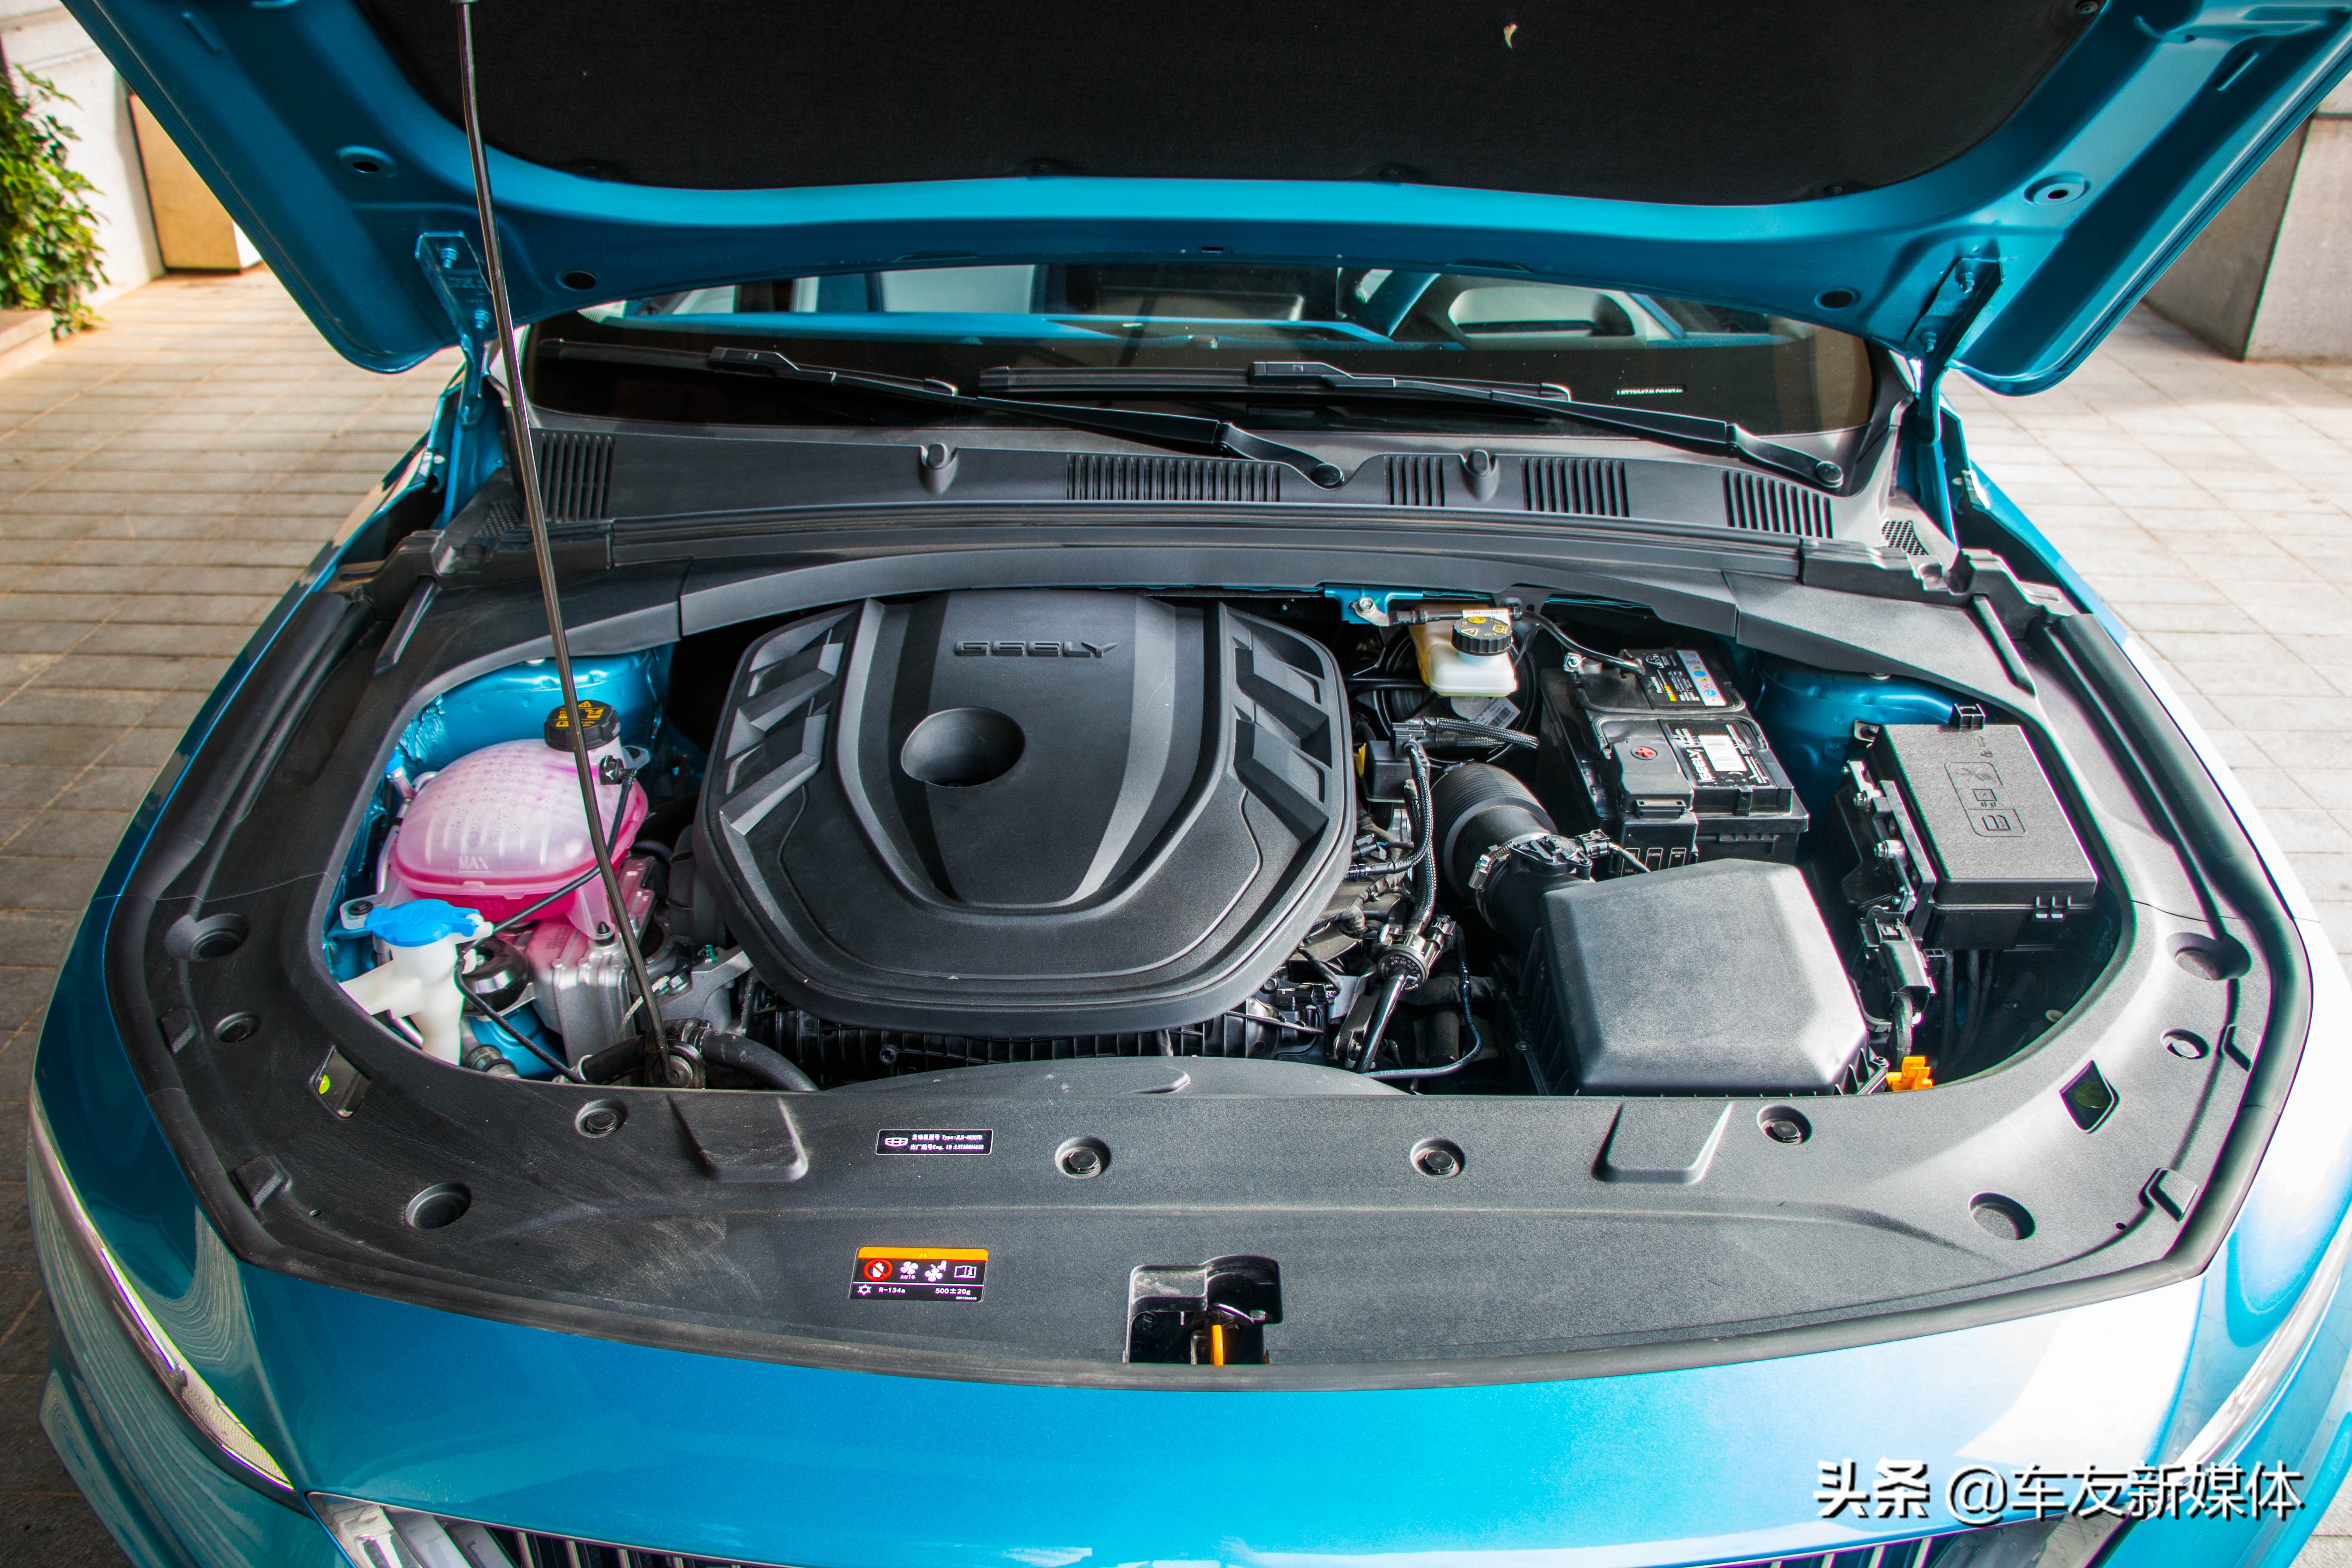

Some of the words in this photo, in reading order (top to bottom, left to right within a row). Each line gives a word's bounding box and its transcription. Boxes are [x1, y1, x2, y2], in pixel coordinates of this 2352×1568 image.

[955, 641, 1118, 658] GEELY
[1686, 748, 1713, 781] GEELY
[459, 856, 489, 870] MAX
[473, 900, 504, 910] MIN
